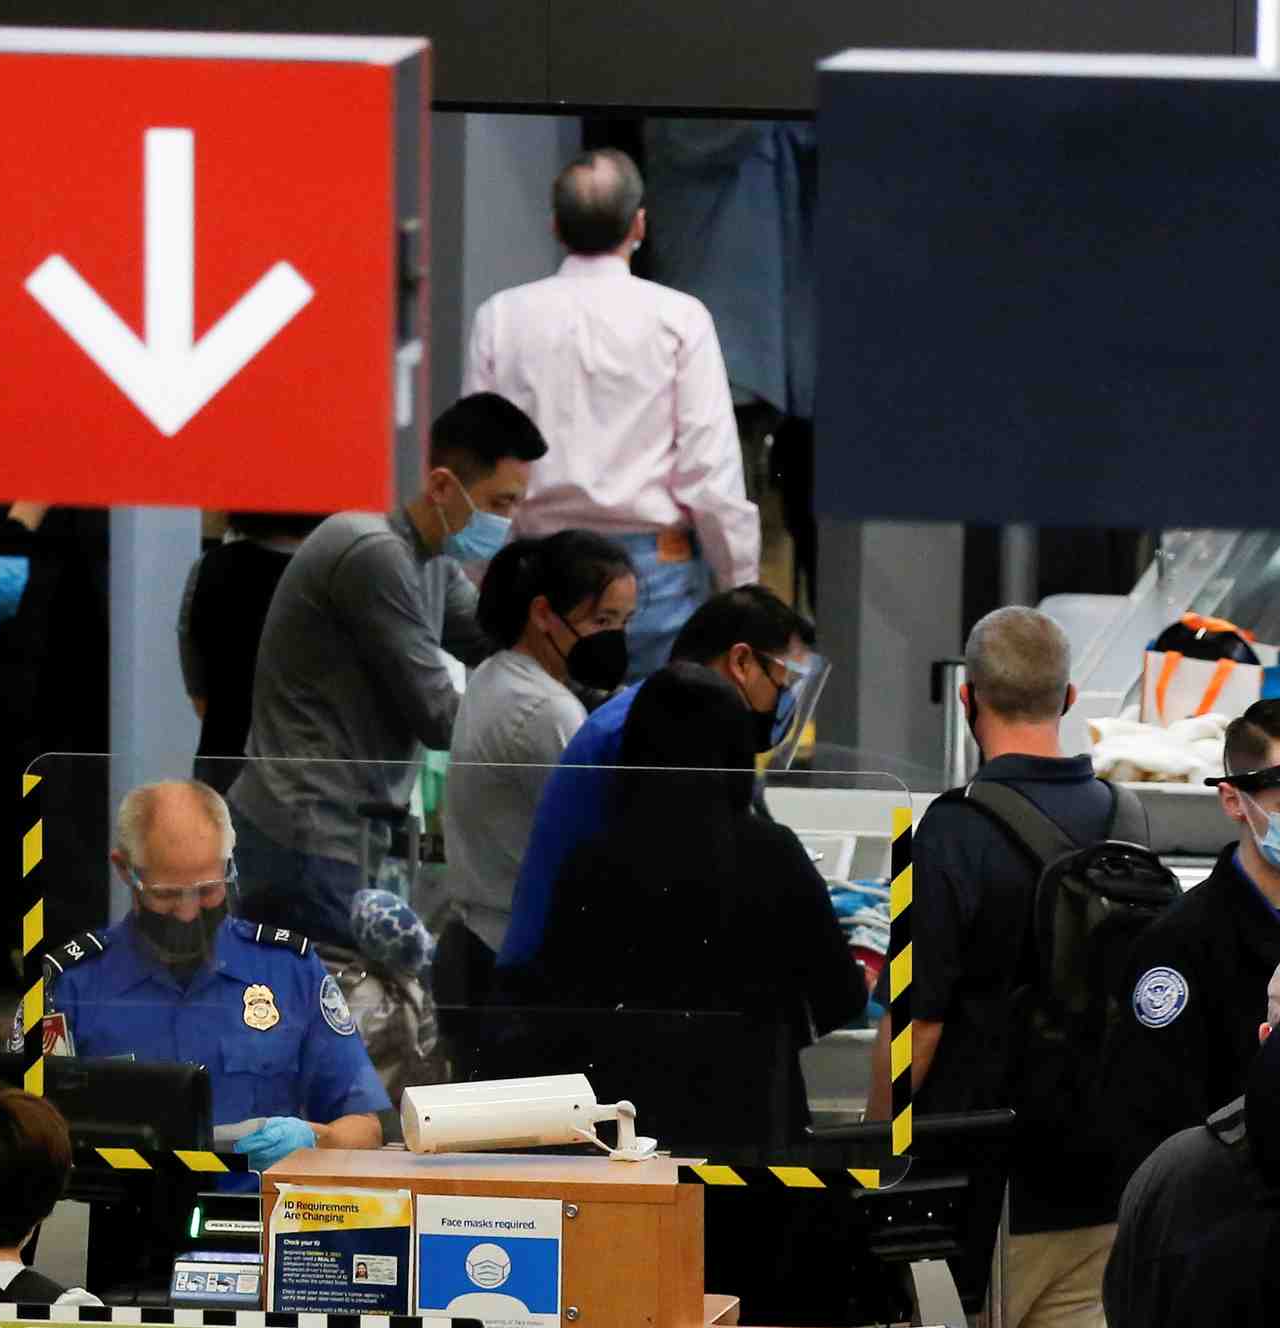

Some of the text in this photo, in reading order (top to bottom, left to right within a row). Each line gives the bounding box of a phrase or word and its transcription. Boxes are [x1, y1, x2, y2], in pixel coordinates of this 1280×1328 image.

[284, 1200, 359, 1213] ID Requirements
[284, 1211, 345, 1223] Are Changing
[441, 1218, 536, 1230] Face masks required.
